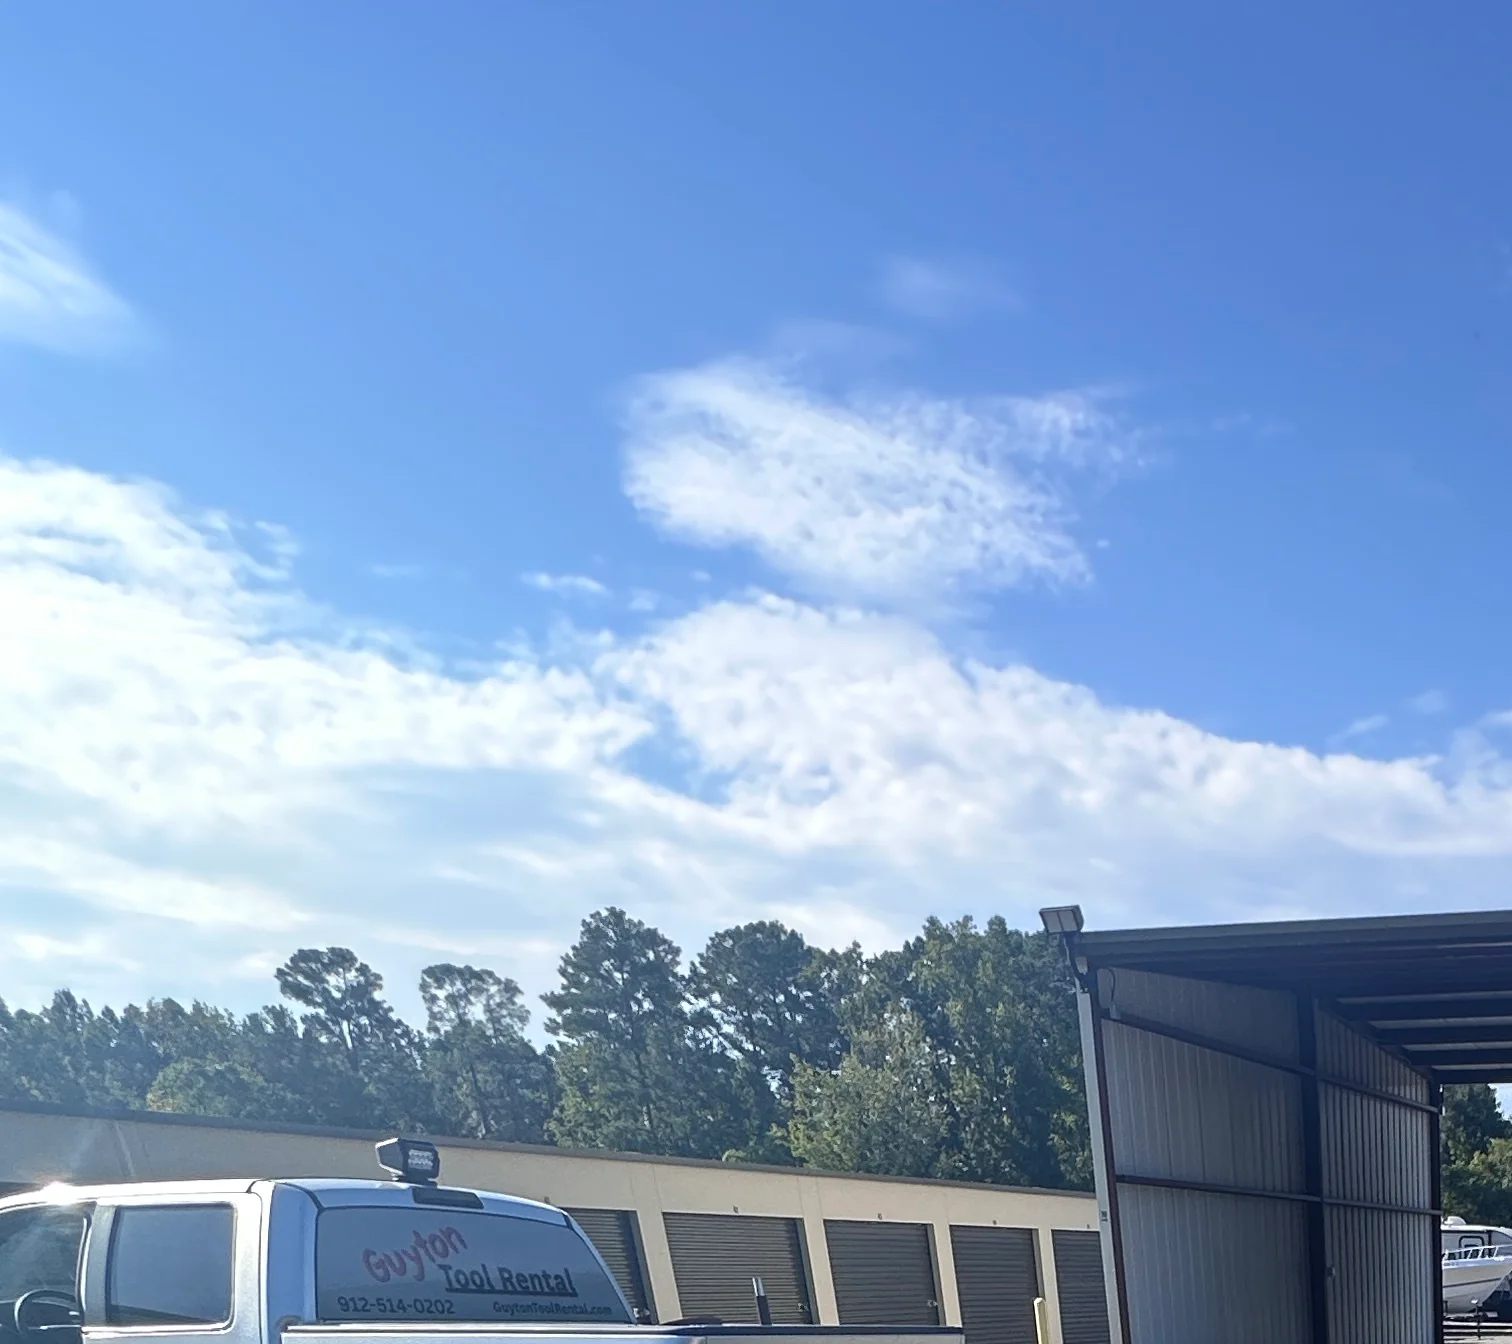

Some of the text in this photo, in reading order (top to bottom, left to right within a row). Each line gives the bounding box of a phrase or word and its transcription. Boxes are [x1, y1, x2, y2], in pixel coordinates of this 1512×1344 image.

[362, 1225, 468, 1283] Guyton
[437, 1263, 578, 1297] Tool Rental
[337, 1296, 456, 1315] 912-514-0202
[492, 1301, 613, 1316] GuytonToolRental.com
